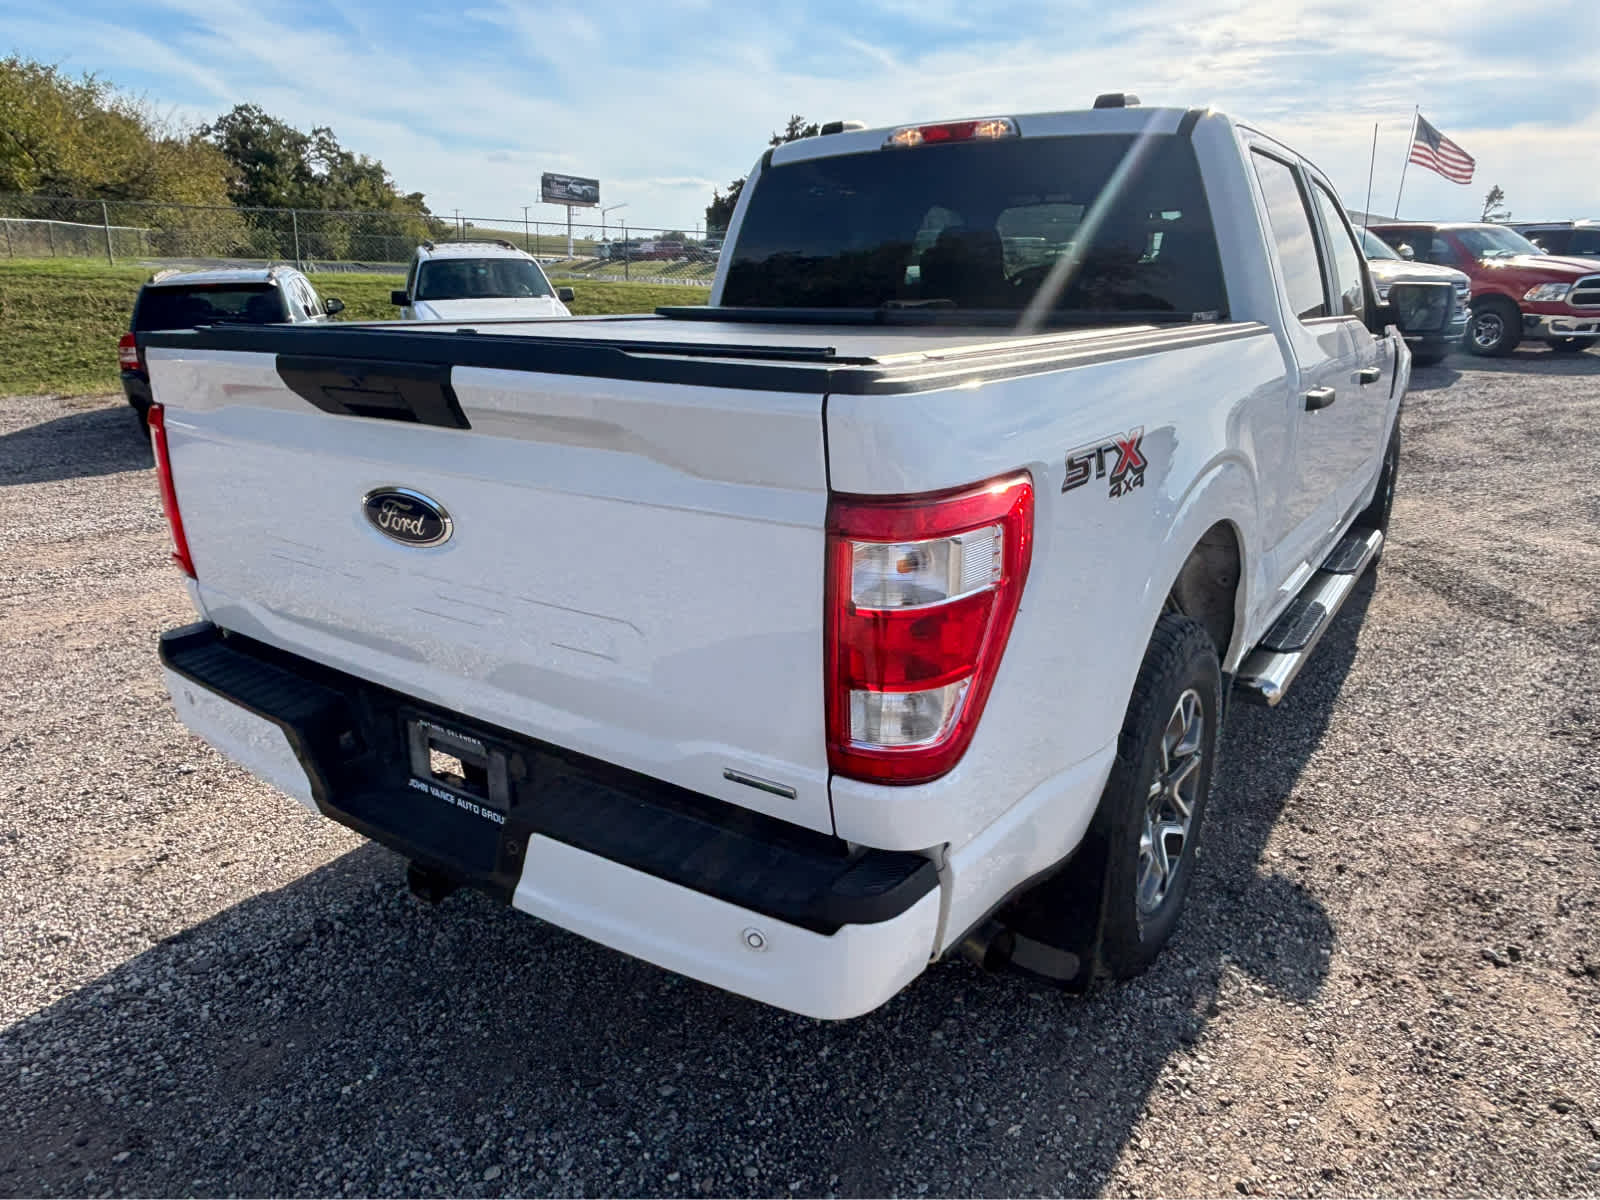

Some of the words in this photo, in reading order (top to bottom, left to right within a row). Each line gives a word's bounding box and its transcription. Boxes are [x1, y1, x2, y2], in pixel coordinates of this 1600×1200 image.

[1062, 425, 1148, 494] STX
[378, 499, 425, 535] Ford
[408, 778, 429, 793] JOHN
[430, 787, 455, 804] VANCE
[457, 798, 480, 815] AUTO
[481, 808, 505, 825] GROU
